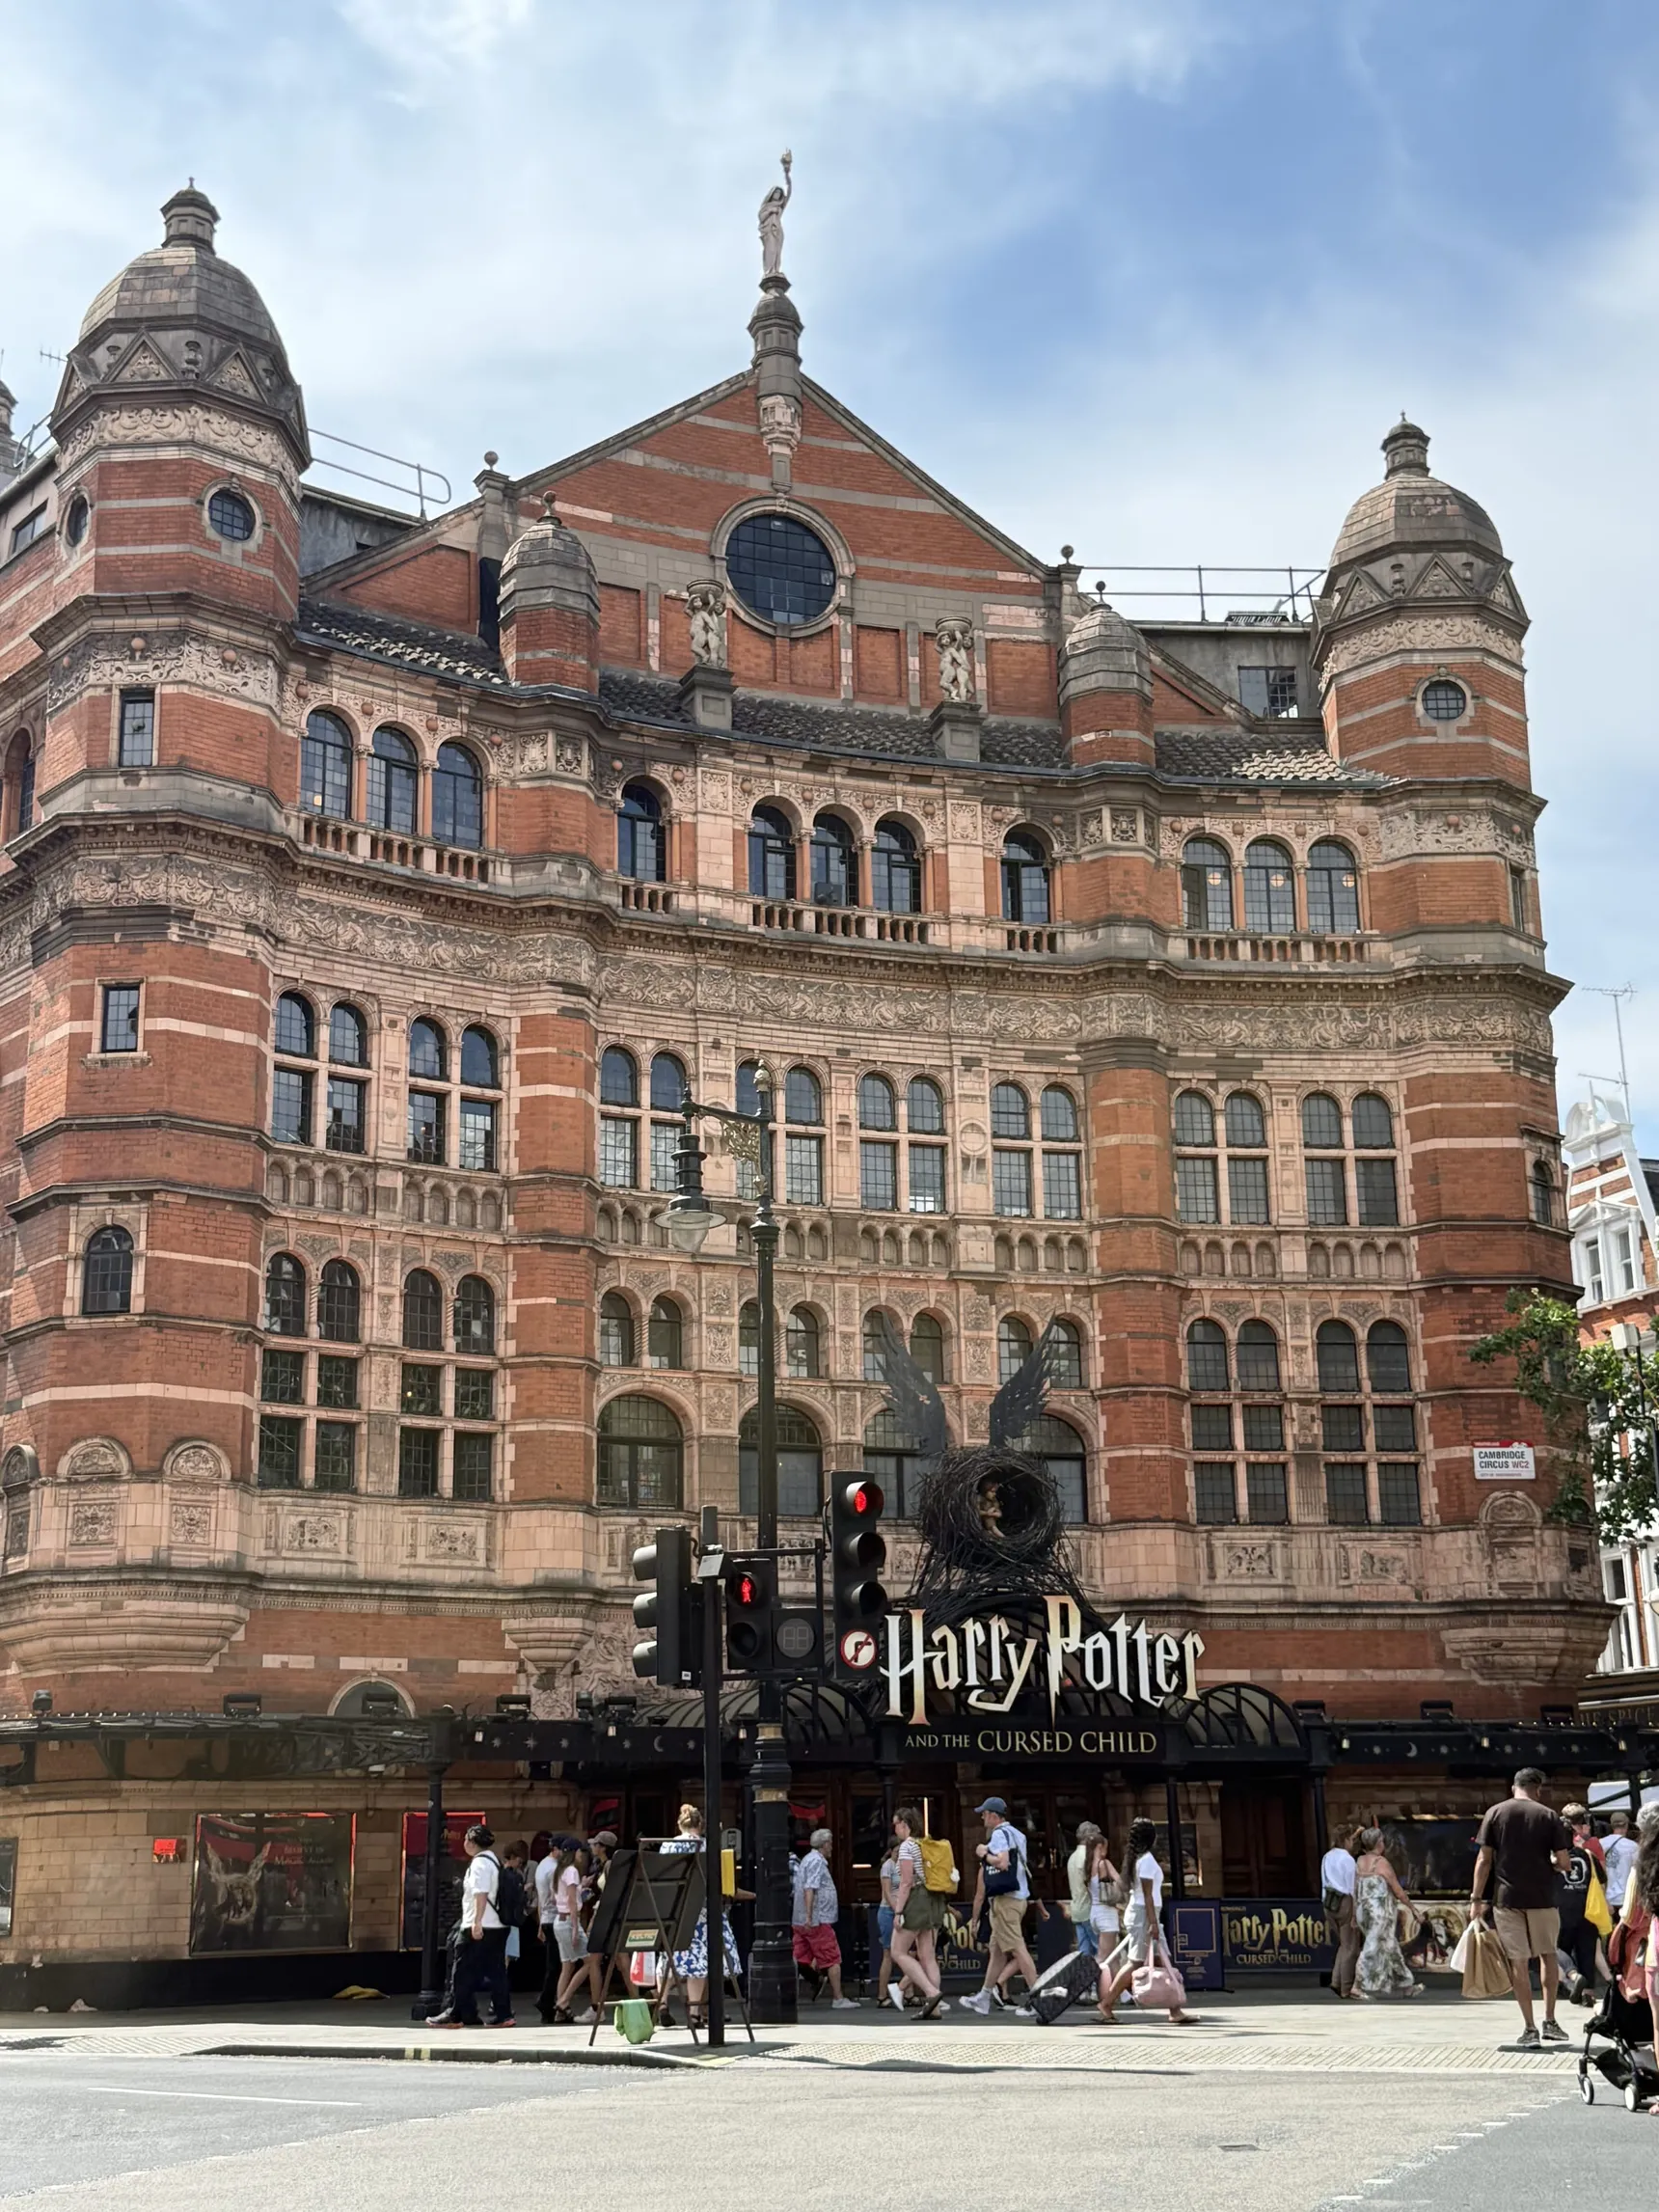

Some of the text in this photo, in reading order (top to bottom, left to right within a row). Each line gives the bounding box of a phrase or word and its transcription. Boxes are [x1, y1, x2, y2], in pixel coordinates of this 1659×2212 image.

[1479, 1450, 1525, 1460] CAMBRIDGE
[879, 1595, 1206, 1732] Harry Potter
[905, 1730, 1157, 1755] AND THE CURSED CHILD
[949, 1959, 981, 1969] CHILD
[1236, 1953, 1312, 1964] CURSED CHILD
